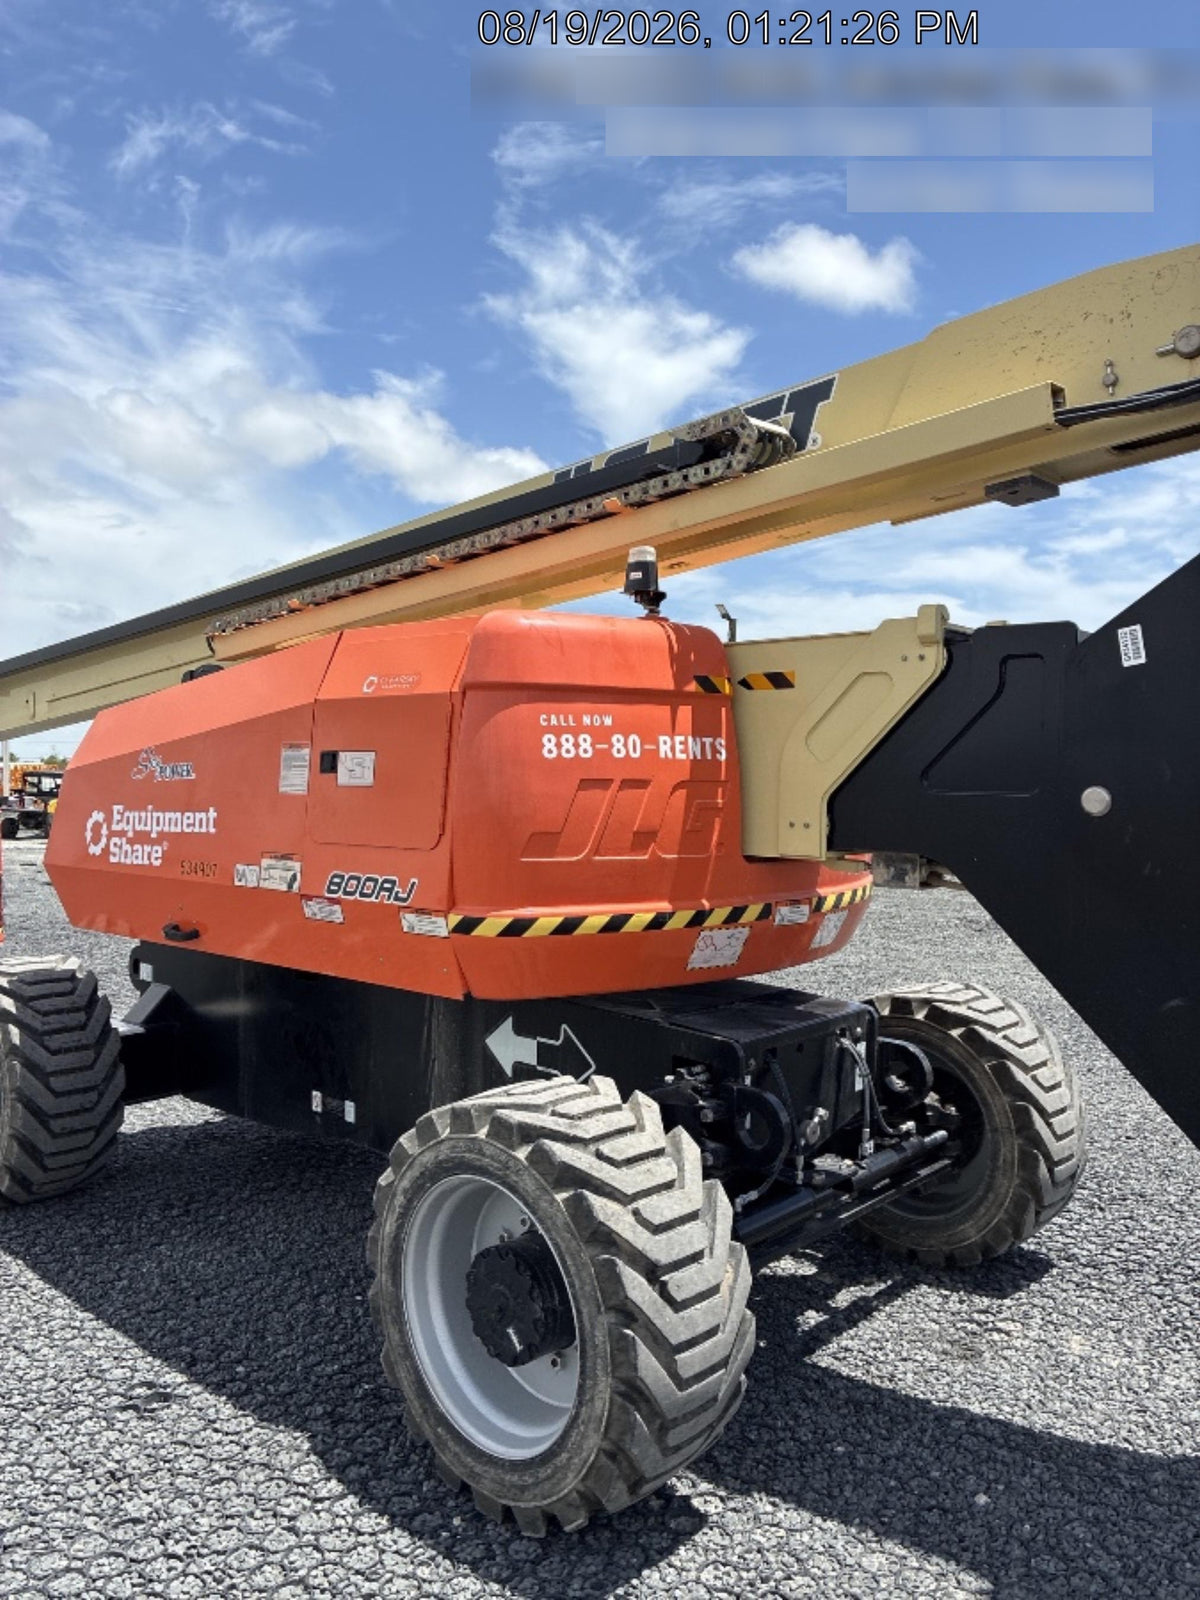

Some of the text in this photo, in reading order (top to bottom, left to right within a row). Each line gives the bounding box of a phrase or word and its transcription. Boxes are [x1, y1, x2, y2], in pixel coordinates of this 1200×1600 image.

[539, 714, 613, 727] CALL NOW
[541, 733, 727, 762] 888-80-RENTS
[111, 805, 217, 838] Equipment
[519, 778, 730, 862] JLG
[325, 870, 419, 906] 800AJ
